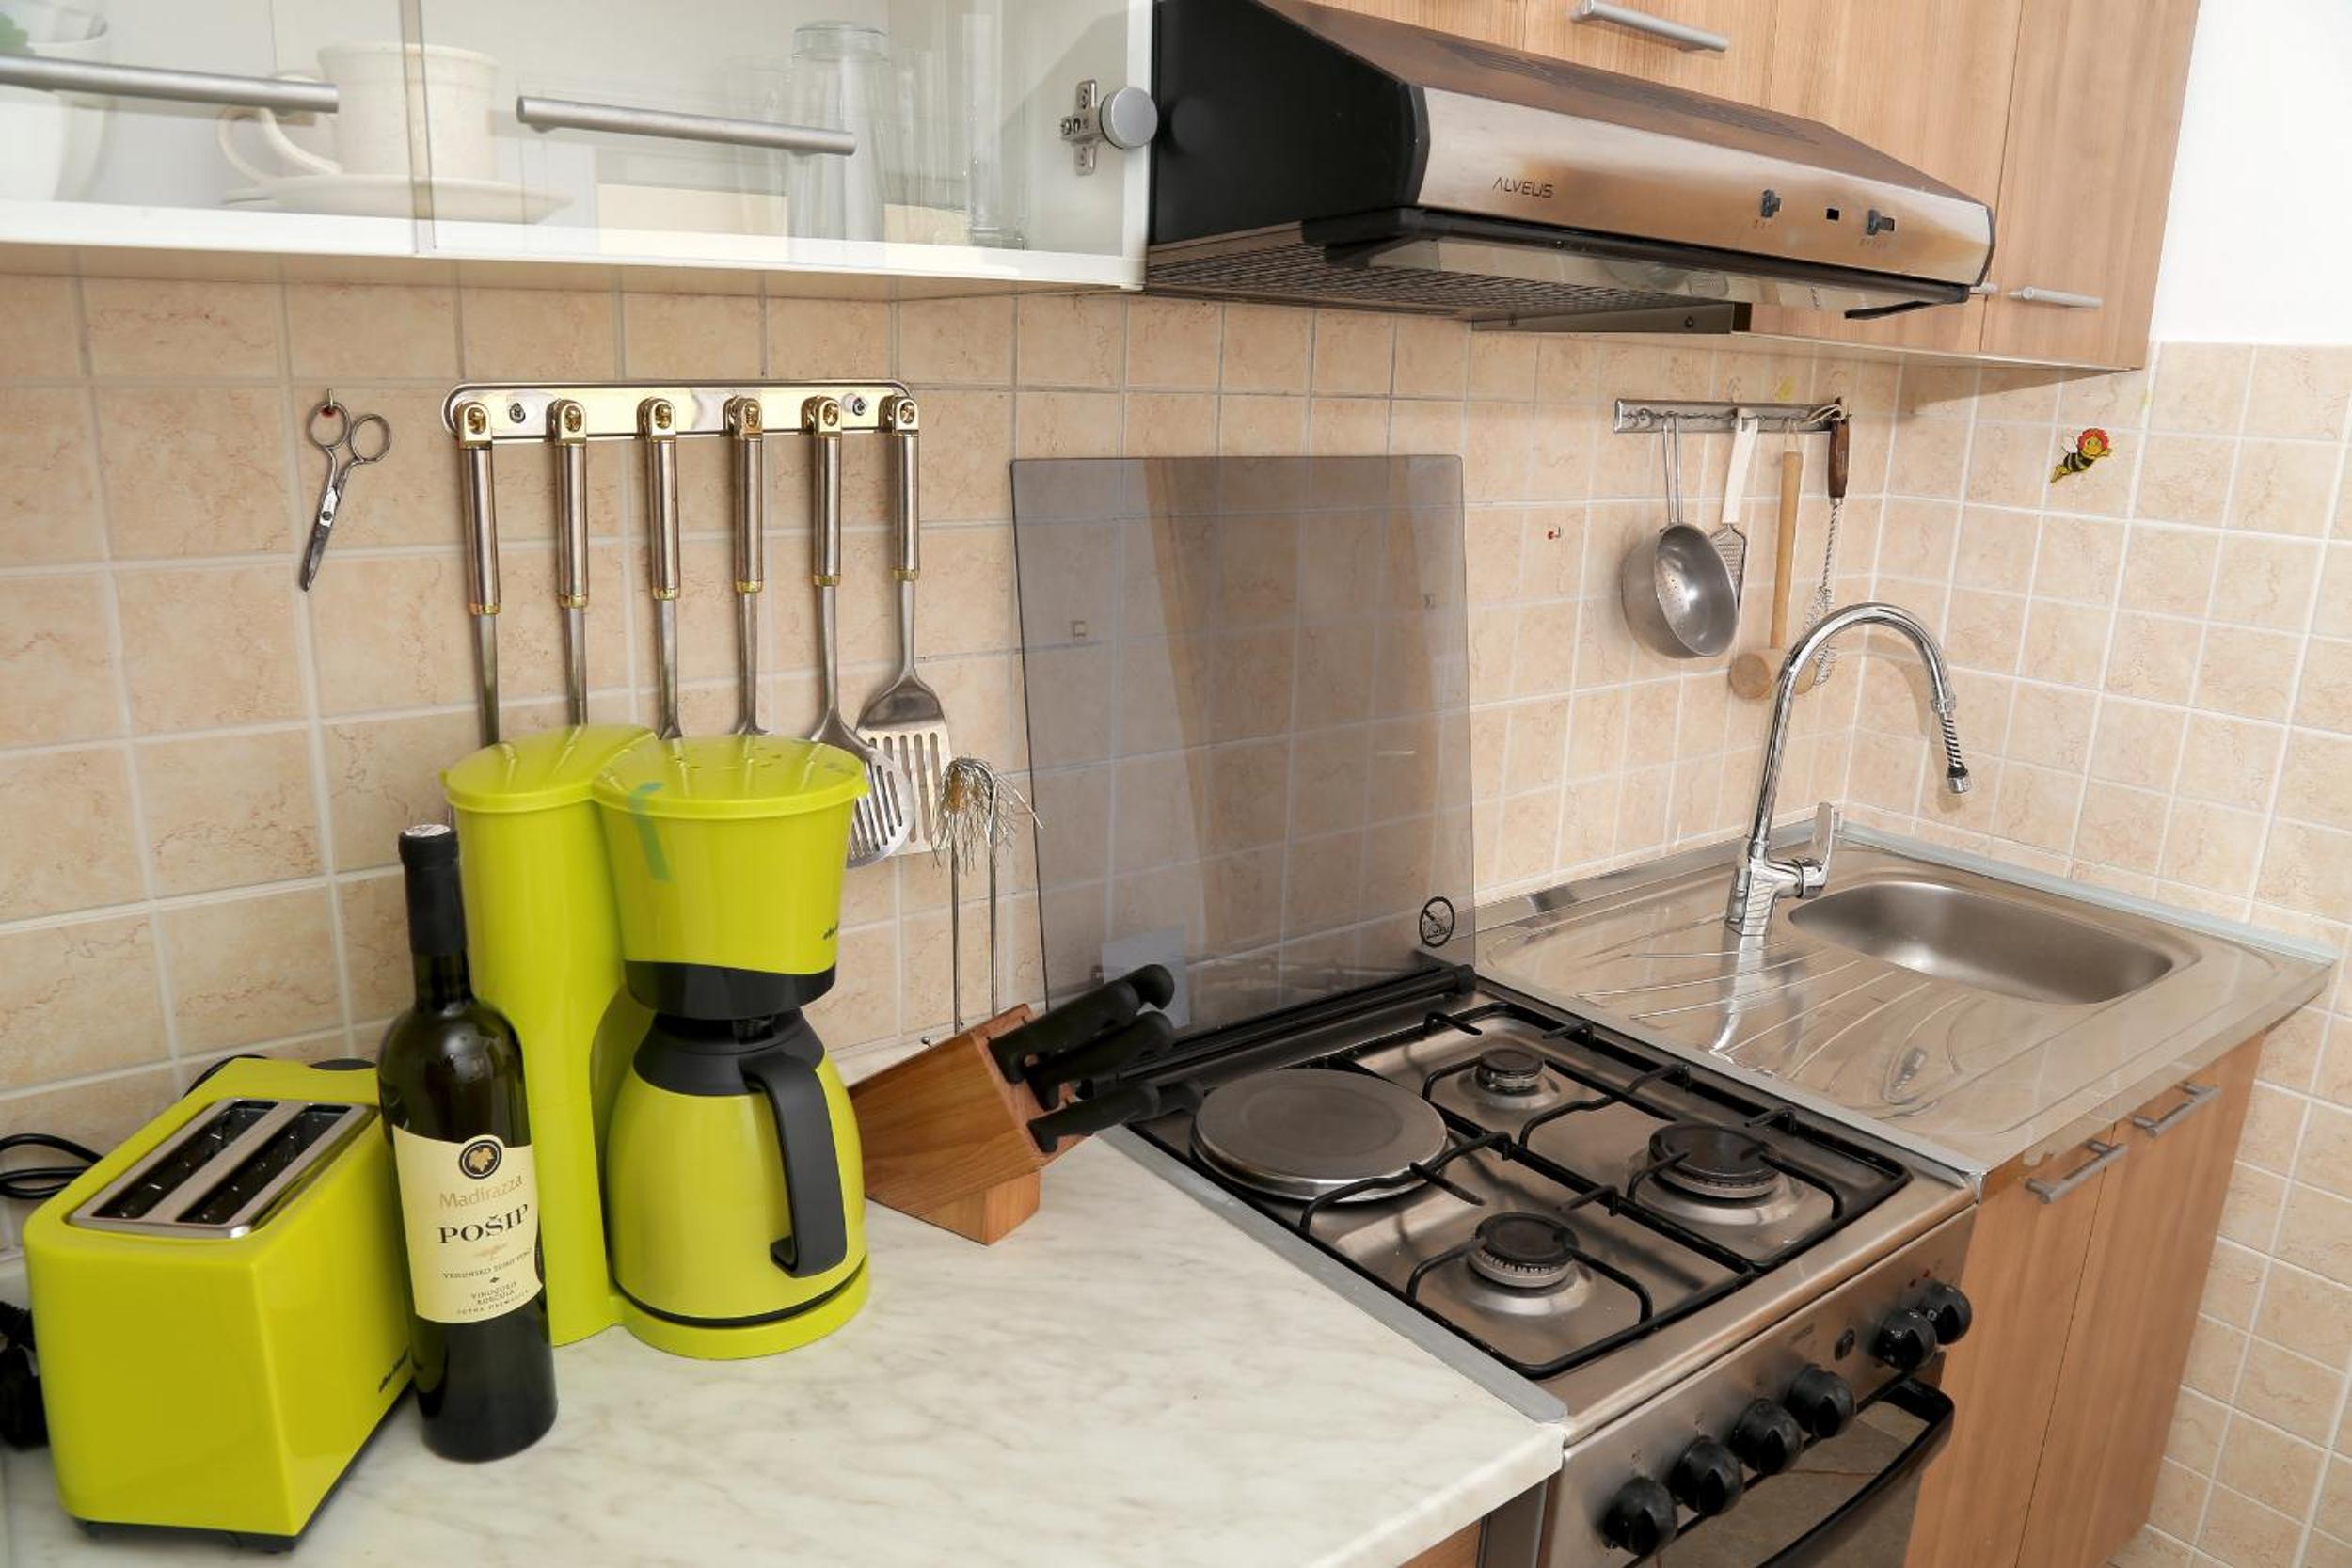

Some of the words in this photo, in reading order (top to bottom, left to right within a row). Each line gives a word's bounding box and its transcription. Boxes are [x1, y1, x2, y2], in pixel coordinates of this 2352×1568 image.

[1492, 176, 1554, 198] ALVEUS
[438, 1175, 523, 1210] Madirazza
[437, 1203, 529, 1244] POŠIP
